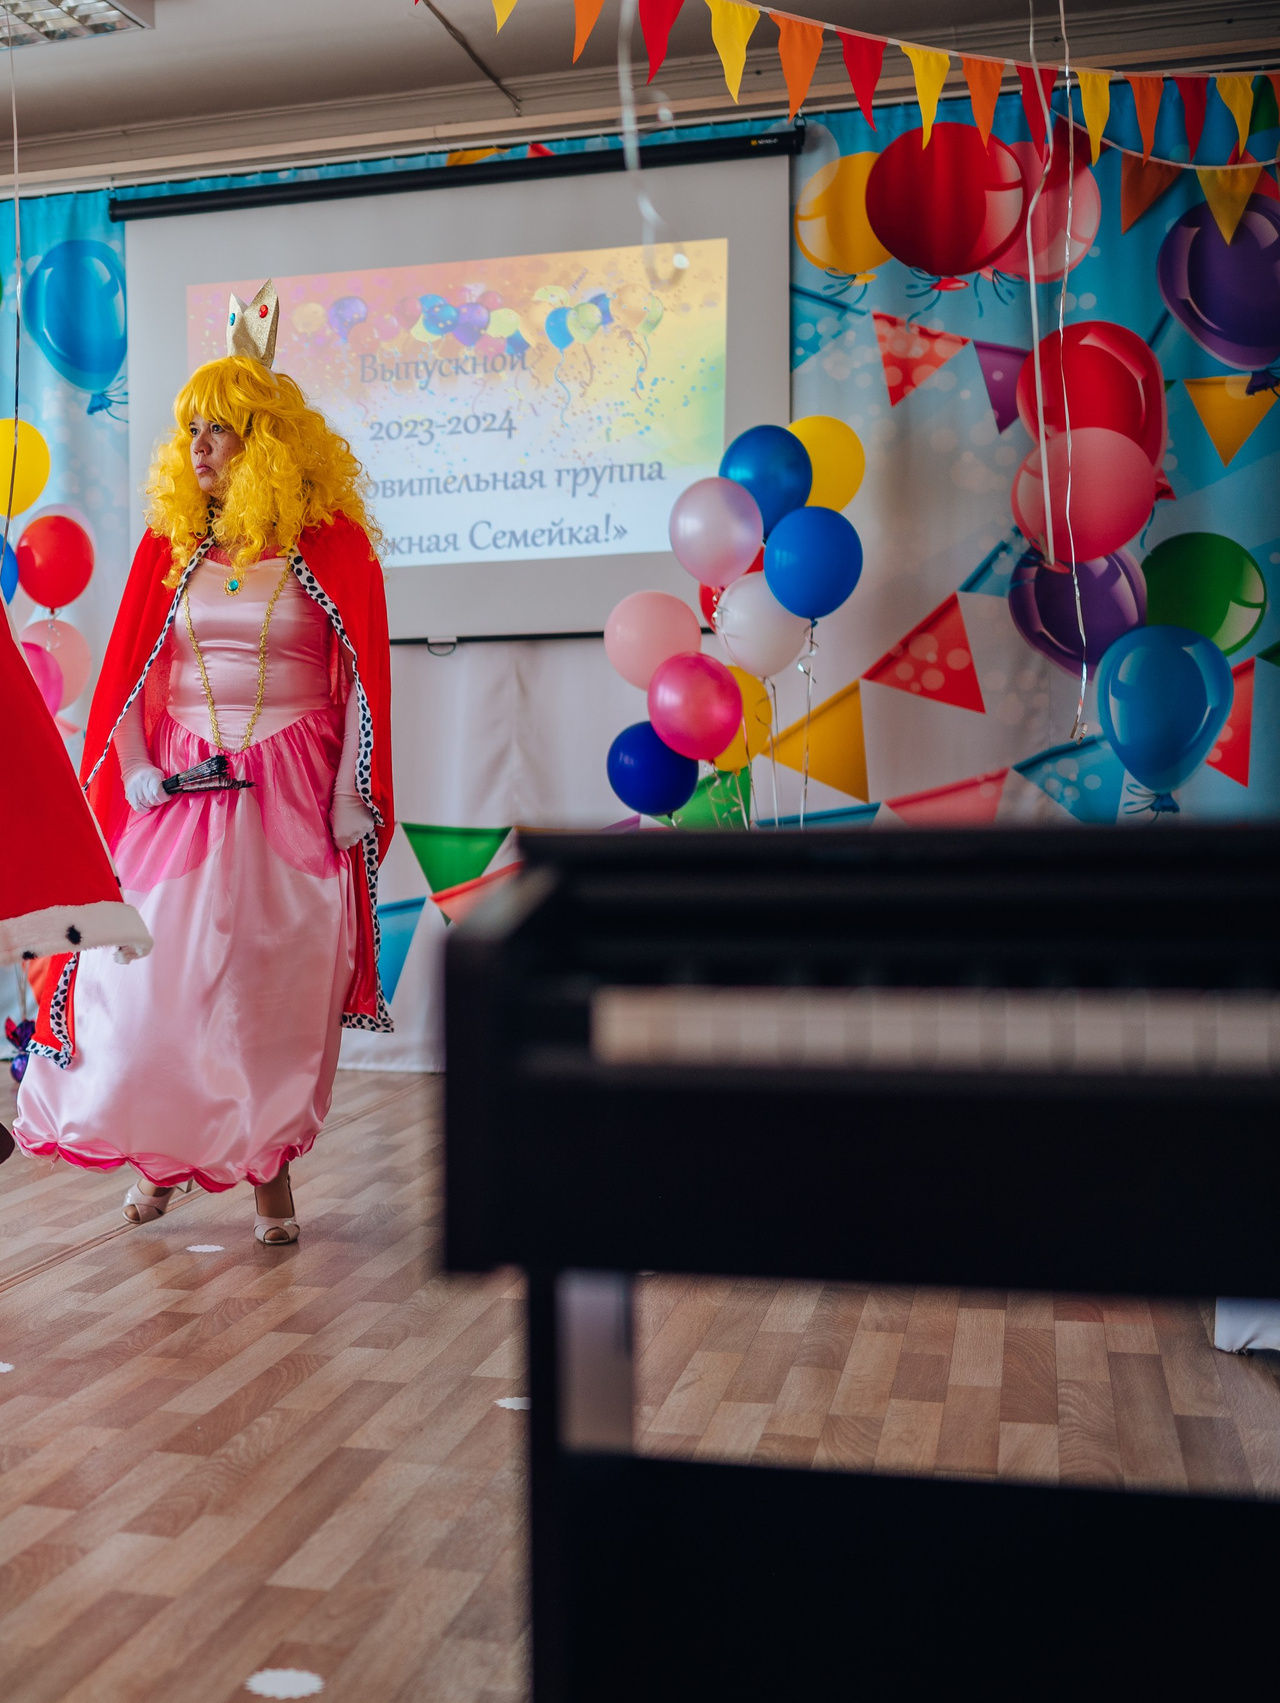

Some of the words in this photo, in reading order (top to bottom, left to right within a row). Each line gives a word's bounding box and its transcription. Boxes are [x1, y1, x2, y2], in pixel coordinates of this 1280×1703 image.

[359, 346, 529, 391] Выпускной
[369, 409, 517, 446] 2023-2024
[554, 460, 667, 498] группа
[468, 513, 628, 550] Семейка!»
